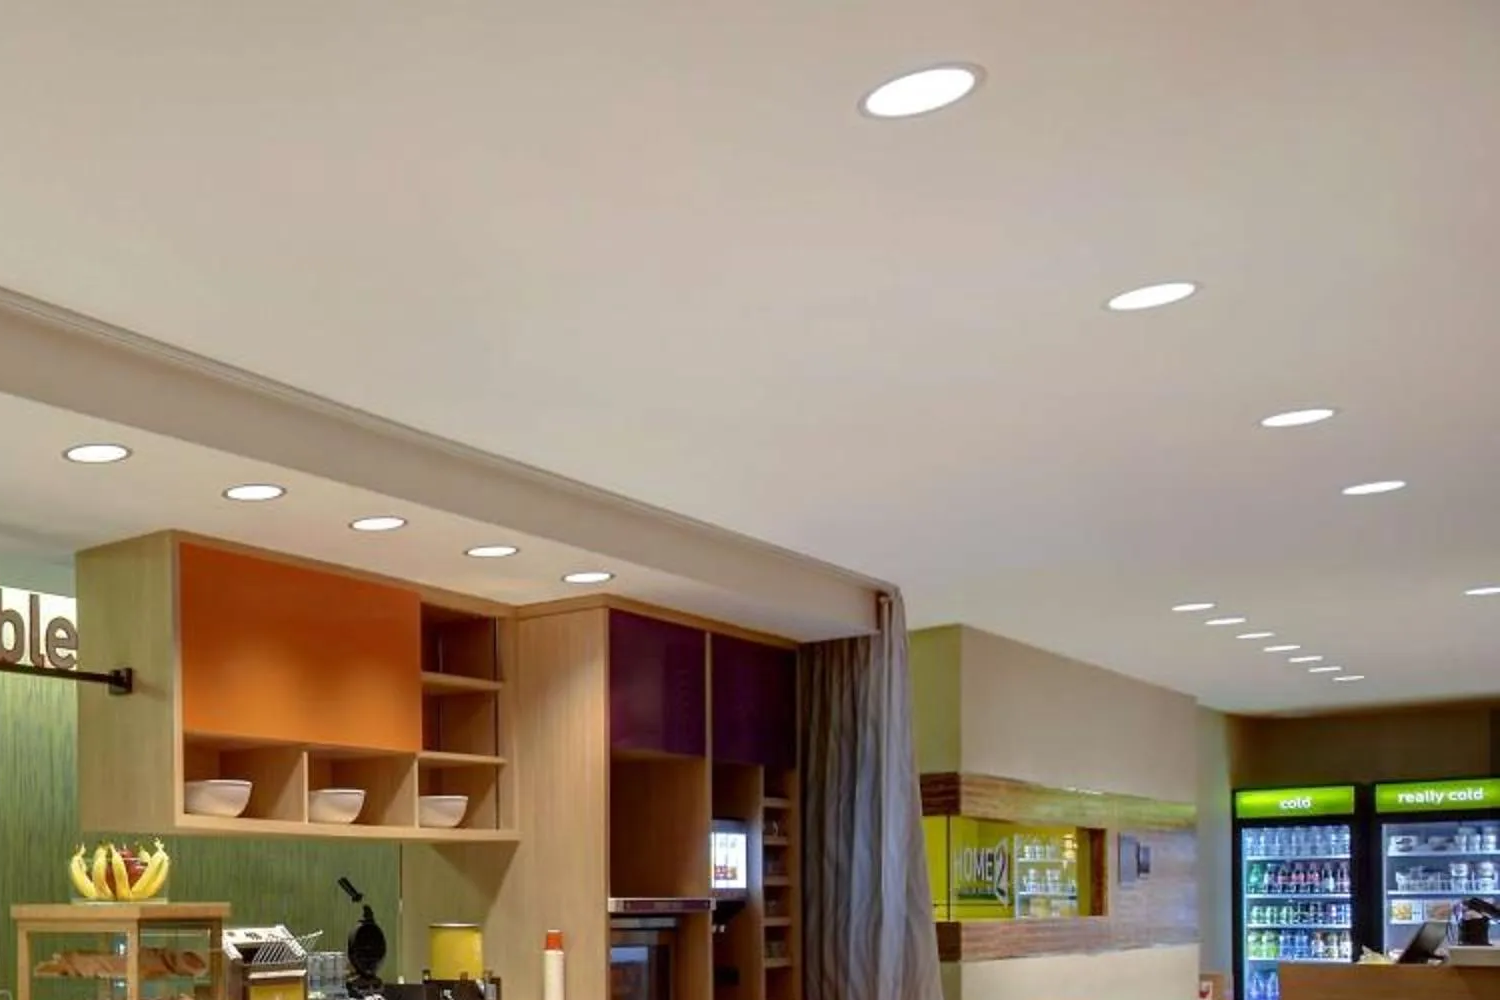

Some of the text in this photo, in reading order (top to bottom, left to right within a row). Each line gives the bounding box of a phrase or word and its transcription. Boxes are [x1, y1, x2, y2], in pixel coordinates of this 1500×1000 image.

[1280, 796, 1311, 809] cold
[1399, 788, 1484, 805] really cold
